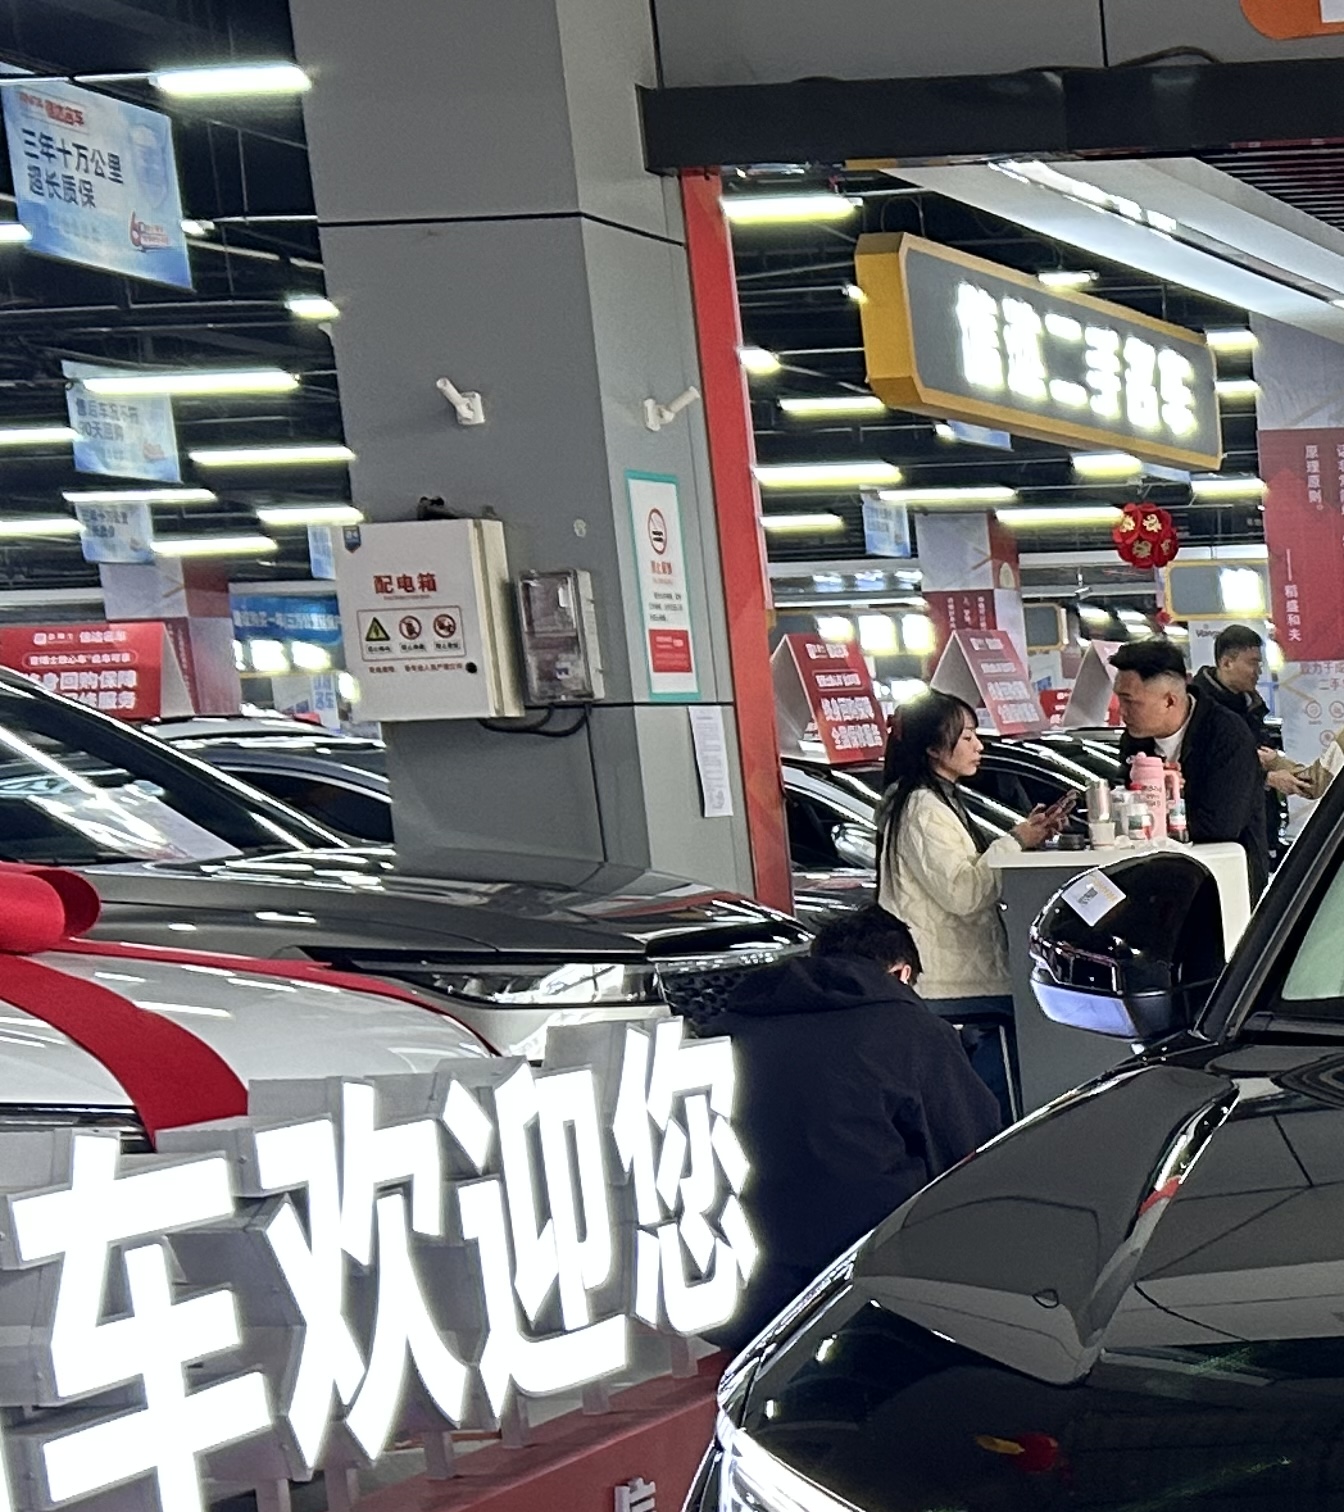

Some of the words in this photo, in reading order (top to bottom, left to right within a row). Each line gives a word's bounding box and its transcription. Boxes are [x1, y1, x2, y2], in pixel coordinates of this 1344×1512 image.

[22, 128, 124, 184] 三年十万公里
[27, 164, 97, 208] 超长质保
[373, 573, 437, 594] 配电箱
